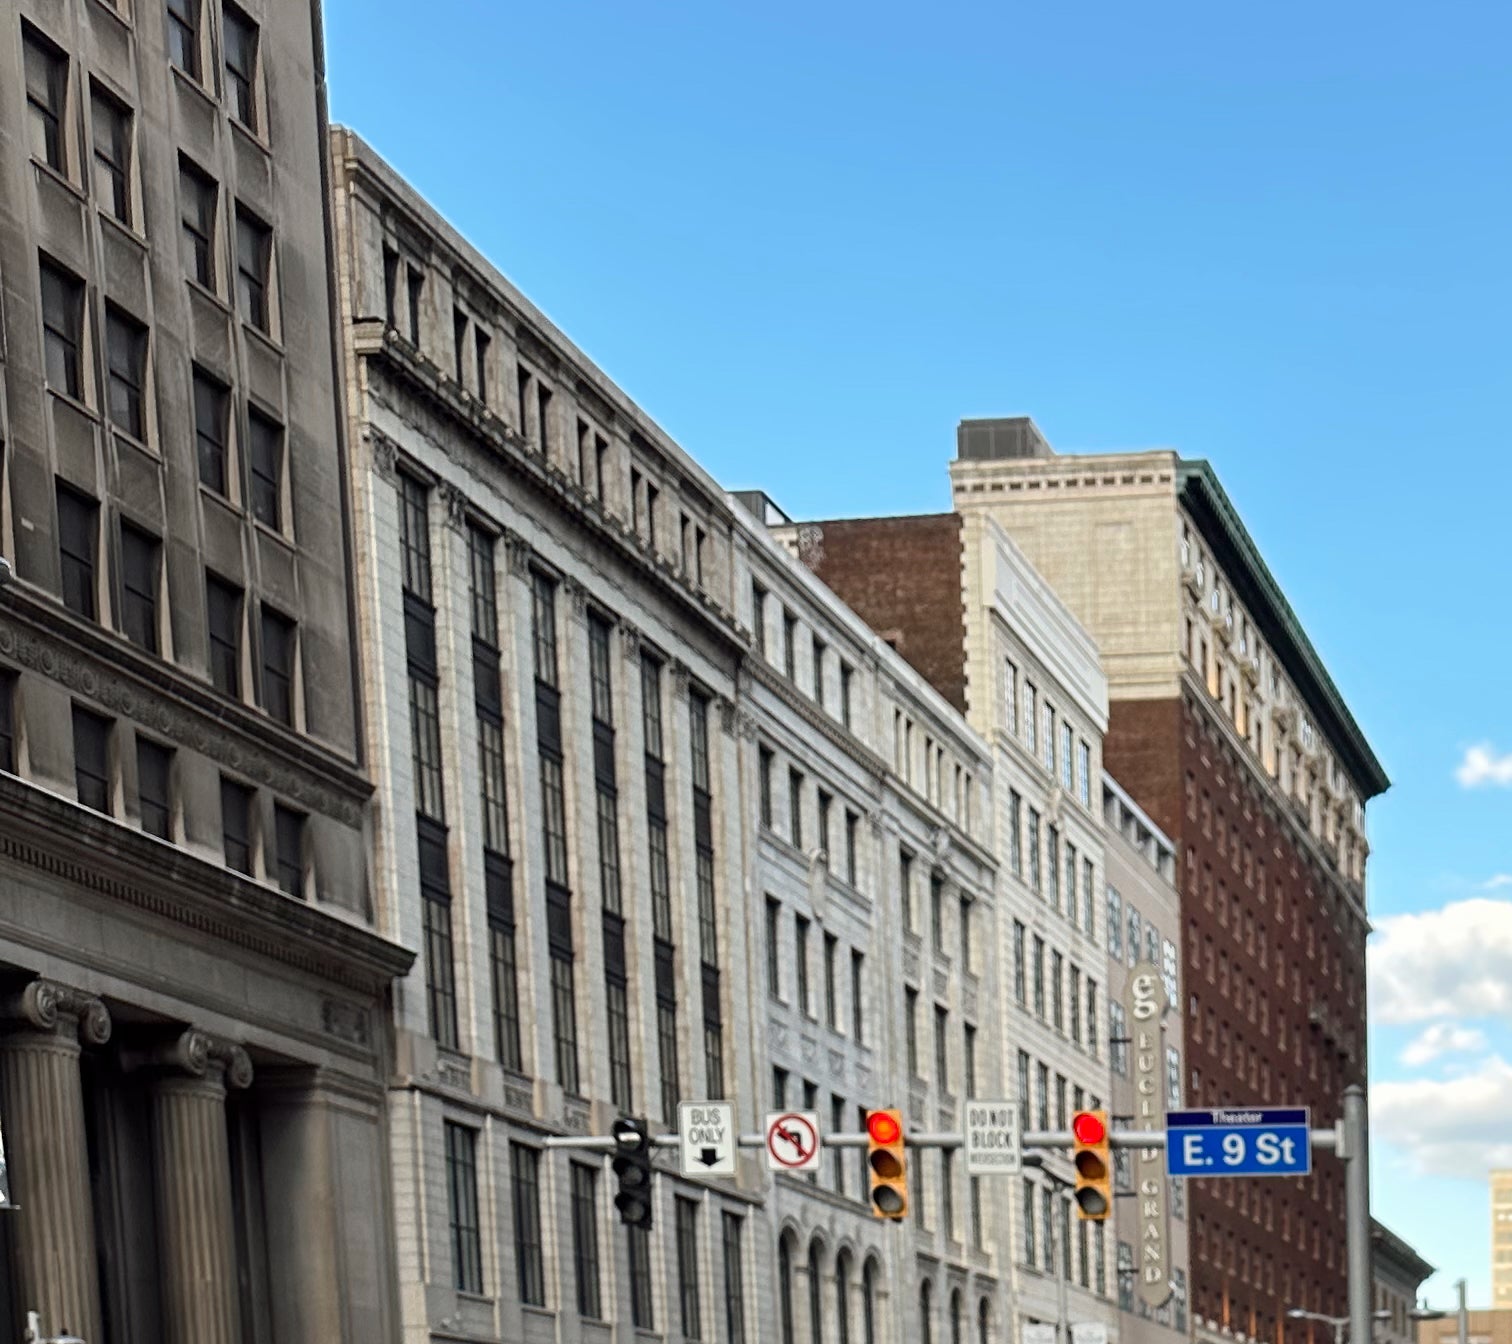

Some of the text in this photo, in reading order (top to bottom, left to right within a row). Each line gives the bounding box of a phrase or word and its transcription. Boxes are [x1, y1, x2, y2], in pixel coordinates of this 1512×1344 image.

[691, 1108, 721, 1126] BUS
[969, 1109, 1013, 1127] DO NOT
[688, 1127, 726, 1145] ONLY
[972, 1130, 1013, 1149] BLOCK
[1183, 1132, 1296, 1167] E. 9 St
[1141, 1180, 1162, 1284] GRAND
